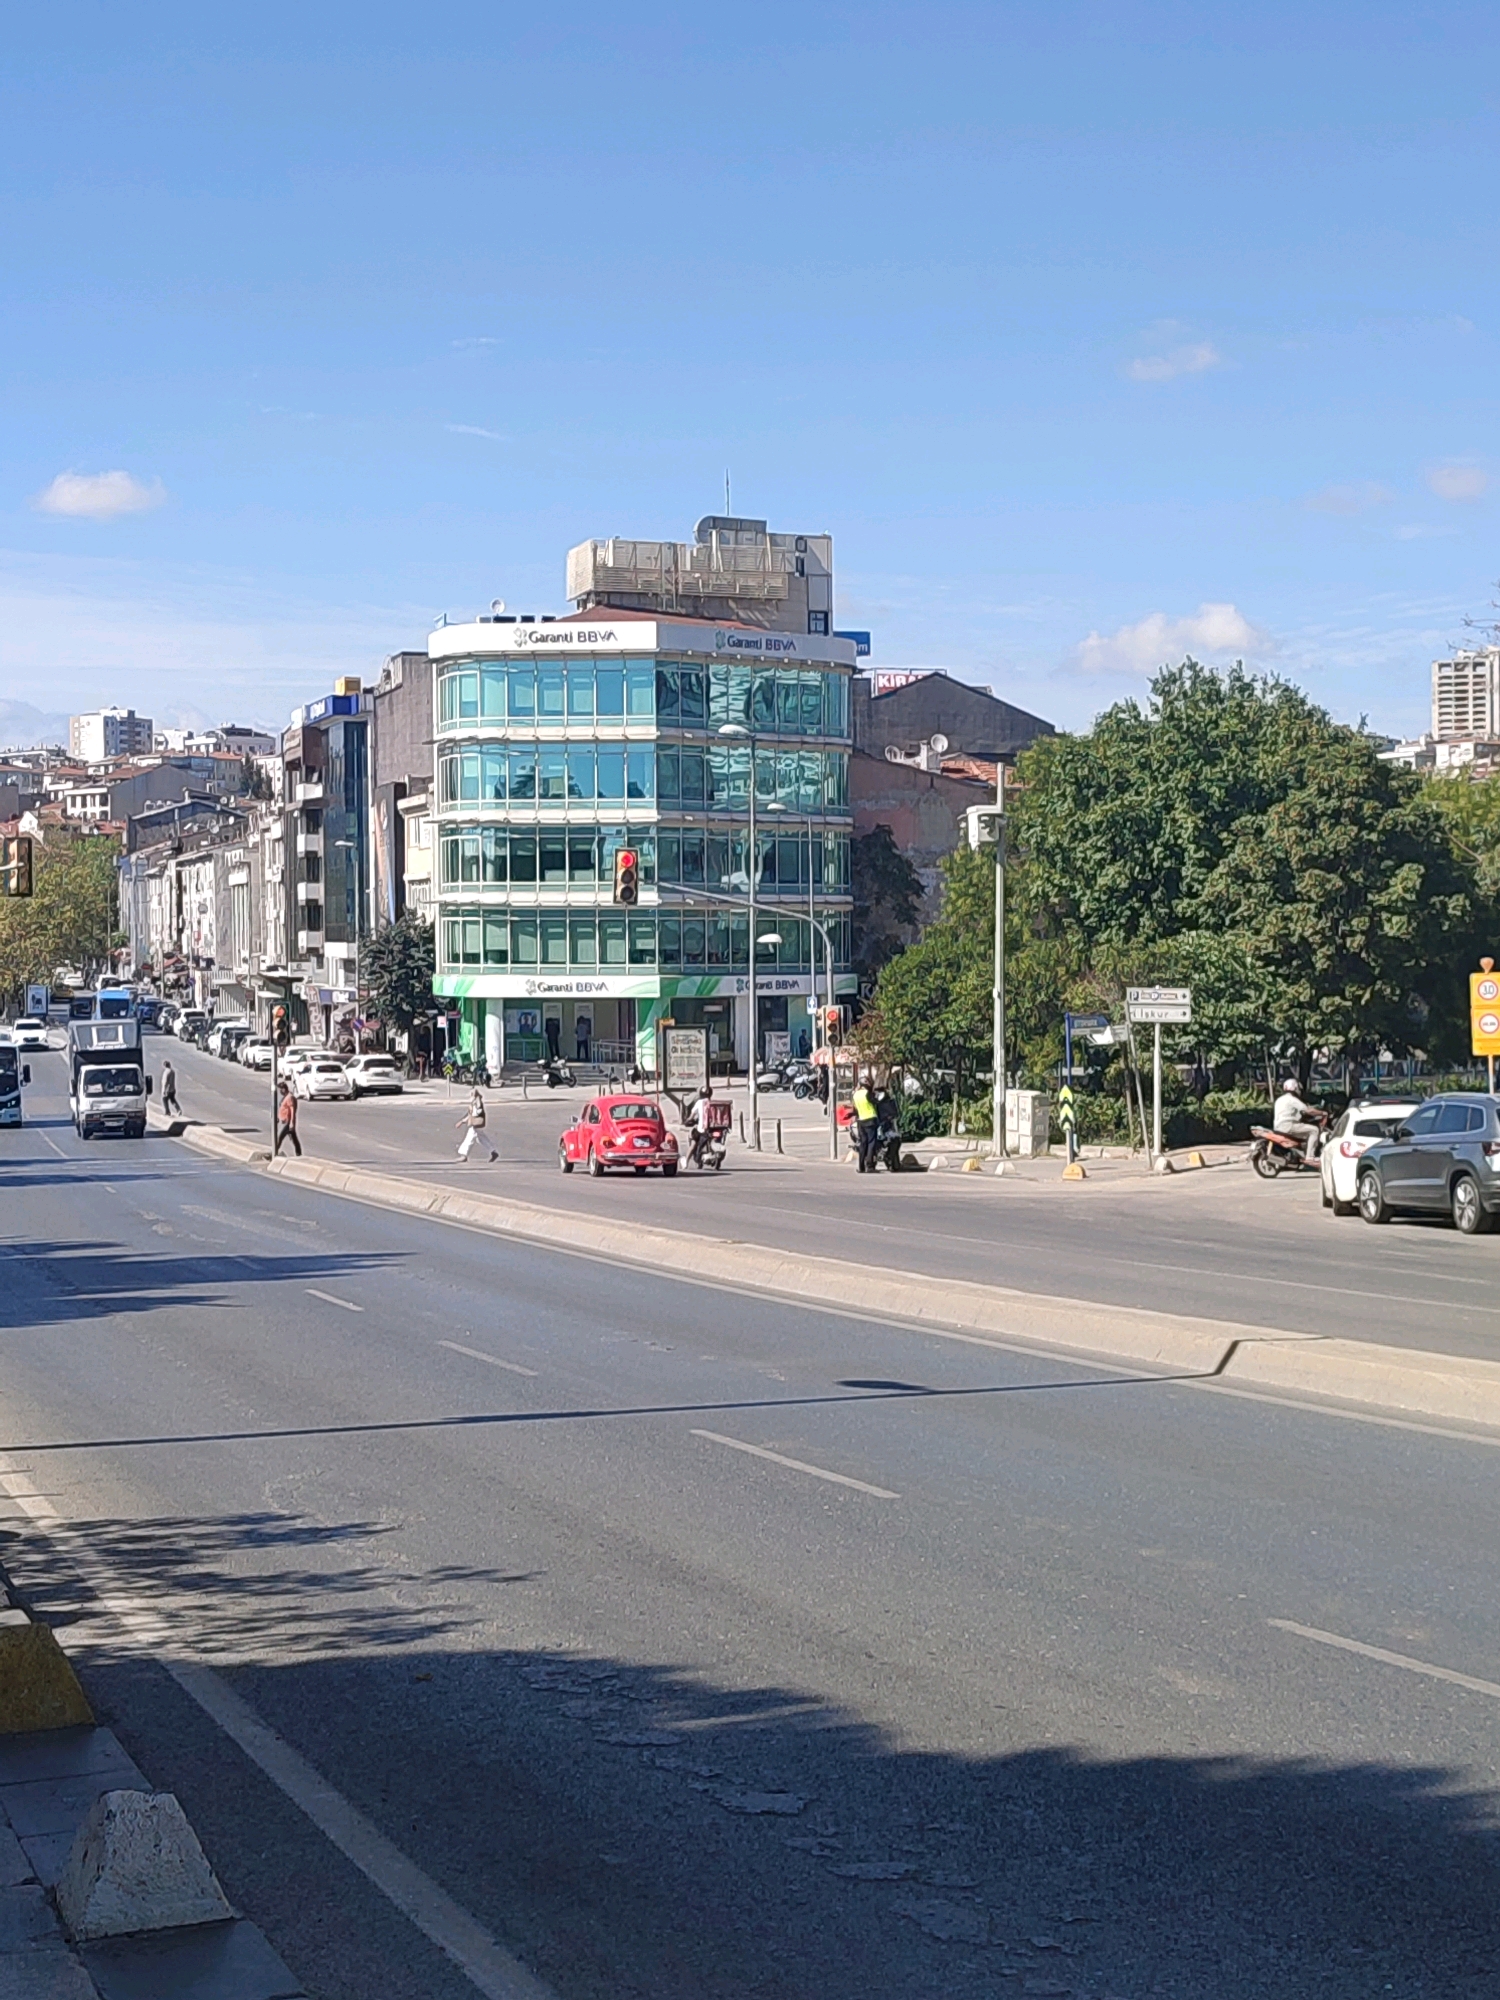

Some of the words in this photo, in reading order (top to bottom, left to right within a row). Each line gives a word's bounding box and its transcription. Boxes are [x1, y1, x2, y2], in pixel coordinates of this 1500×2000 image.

[528, 630, 574, 643] Garanti
[577, 630, 618, 642] BBVA
[727, 634, 762, 650] Garanti
[765, 638, 797, 651] BBVA
[537, 981, 573, 993] Garanti
[575, 981, 609, 992] BBVA
[775, 979, 800, 990] BBVA
